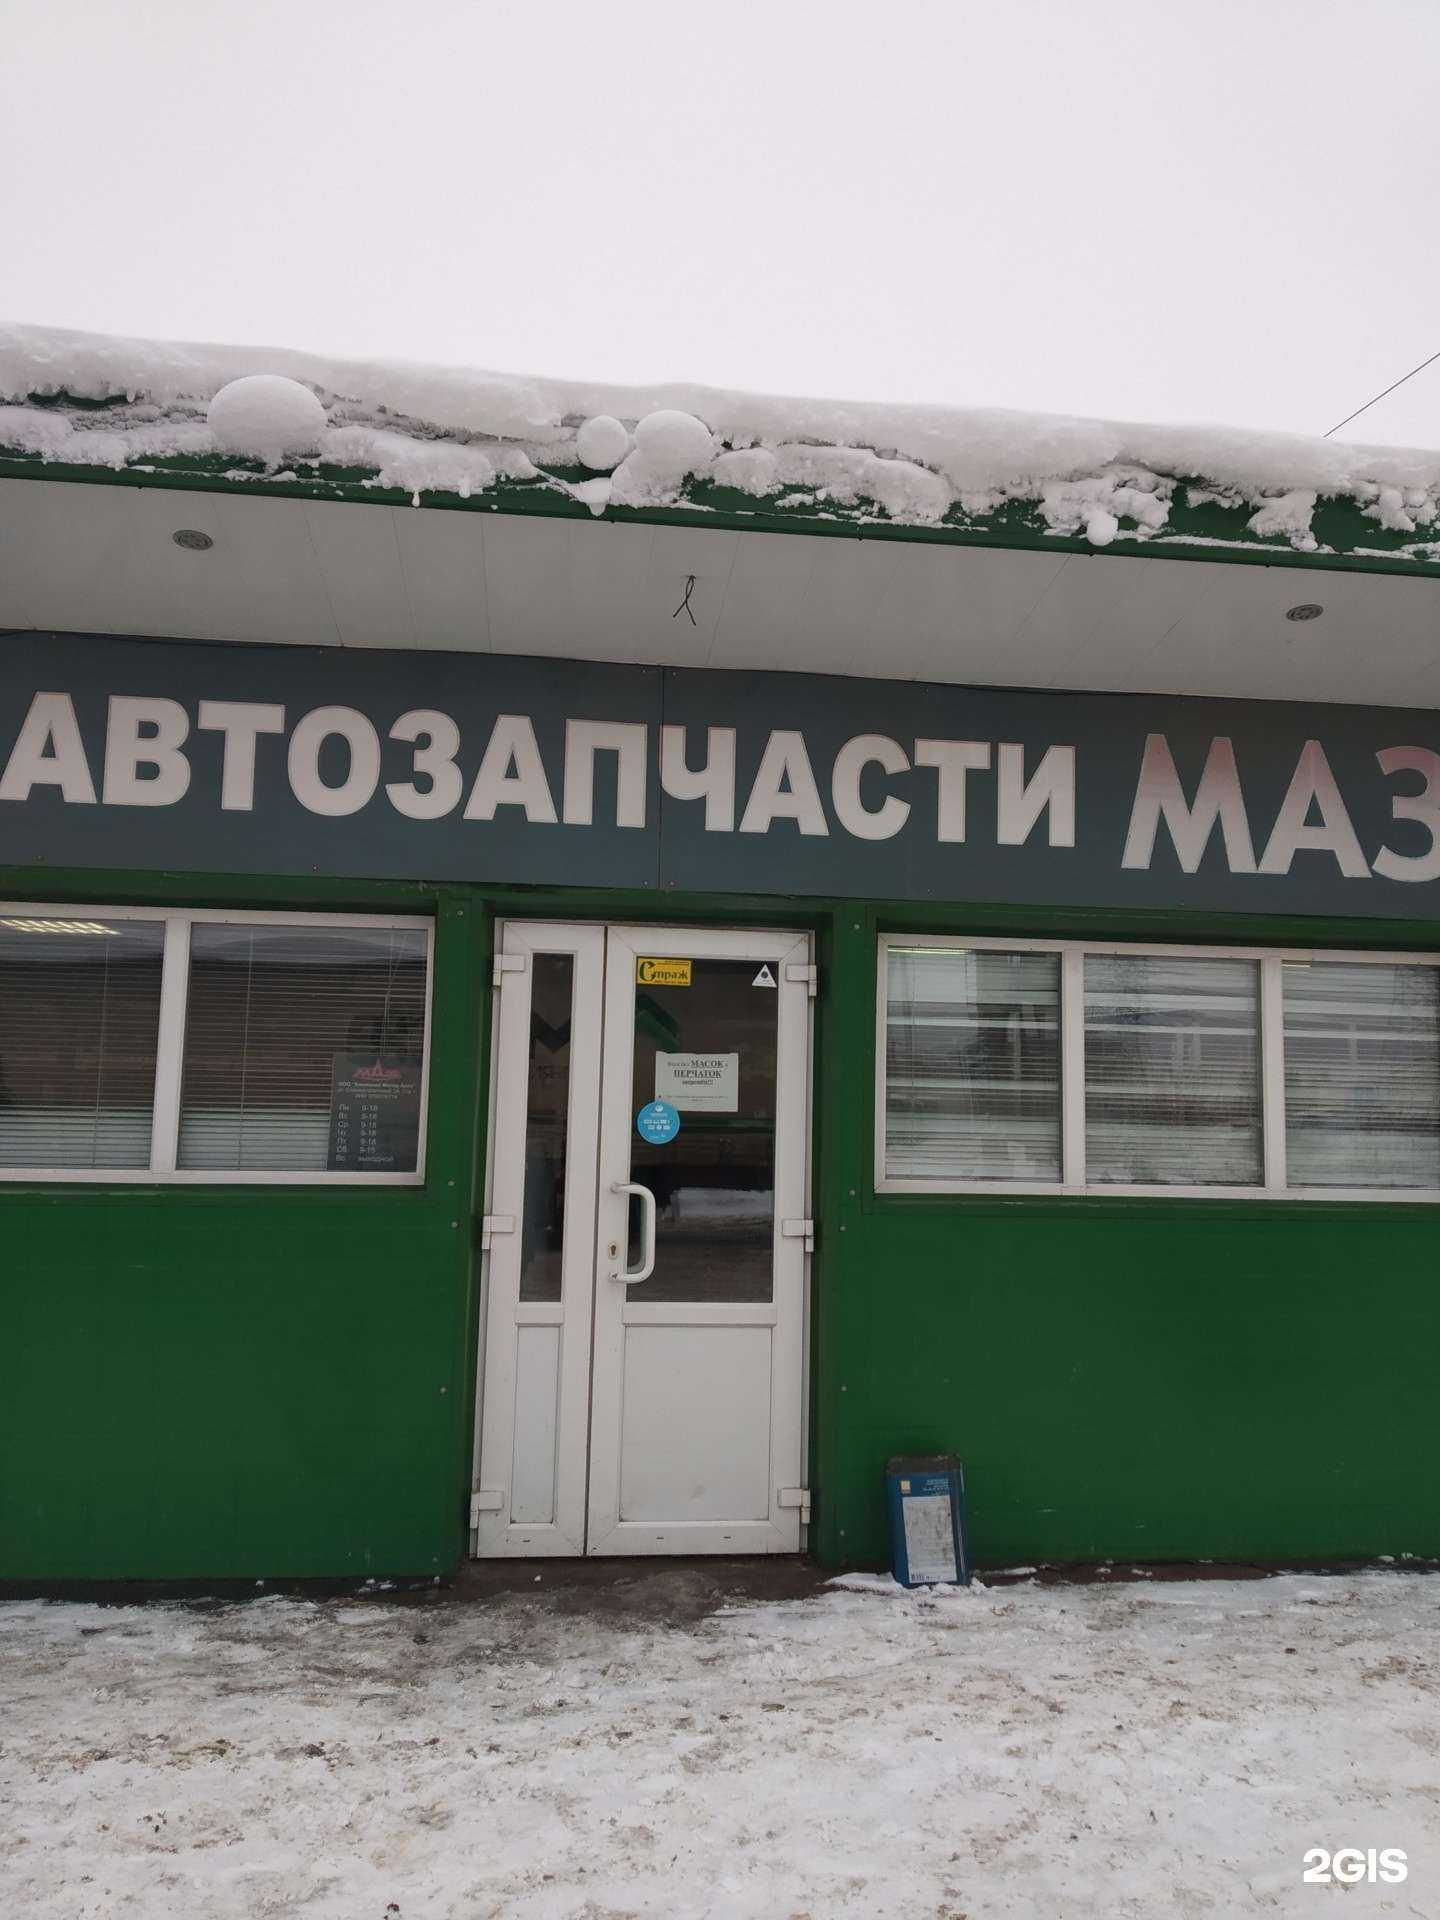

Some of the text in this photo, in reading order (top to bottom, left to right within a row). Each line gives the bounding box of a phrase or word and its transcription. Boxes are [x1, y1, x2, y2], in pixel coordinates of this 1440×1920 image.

[0, 691, 1440, 883] АВТОЗАПЧАСТИ МАЗ
[639, 960, 688, 981] Страж
[690, 1060, 724, 1068] МАСОК
[673, 1069, 723, 1079] ПЕРЧАТОК
